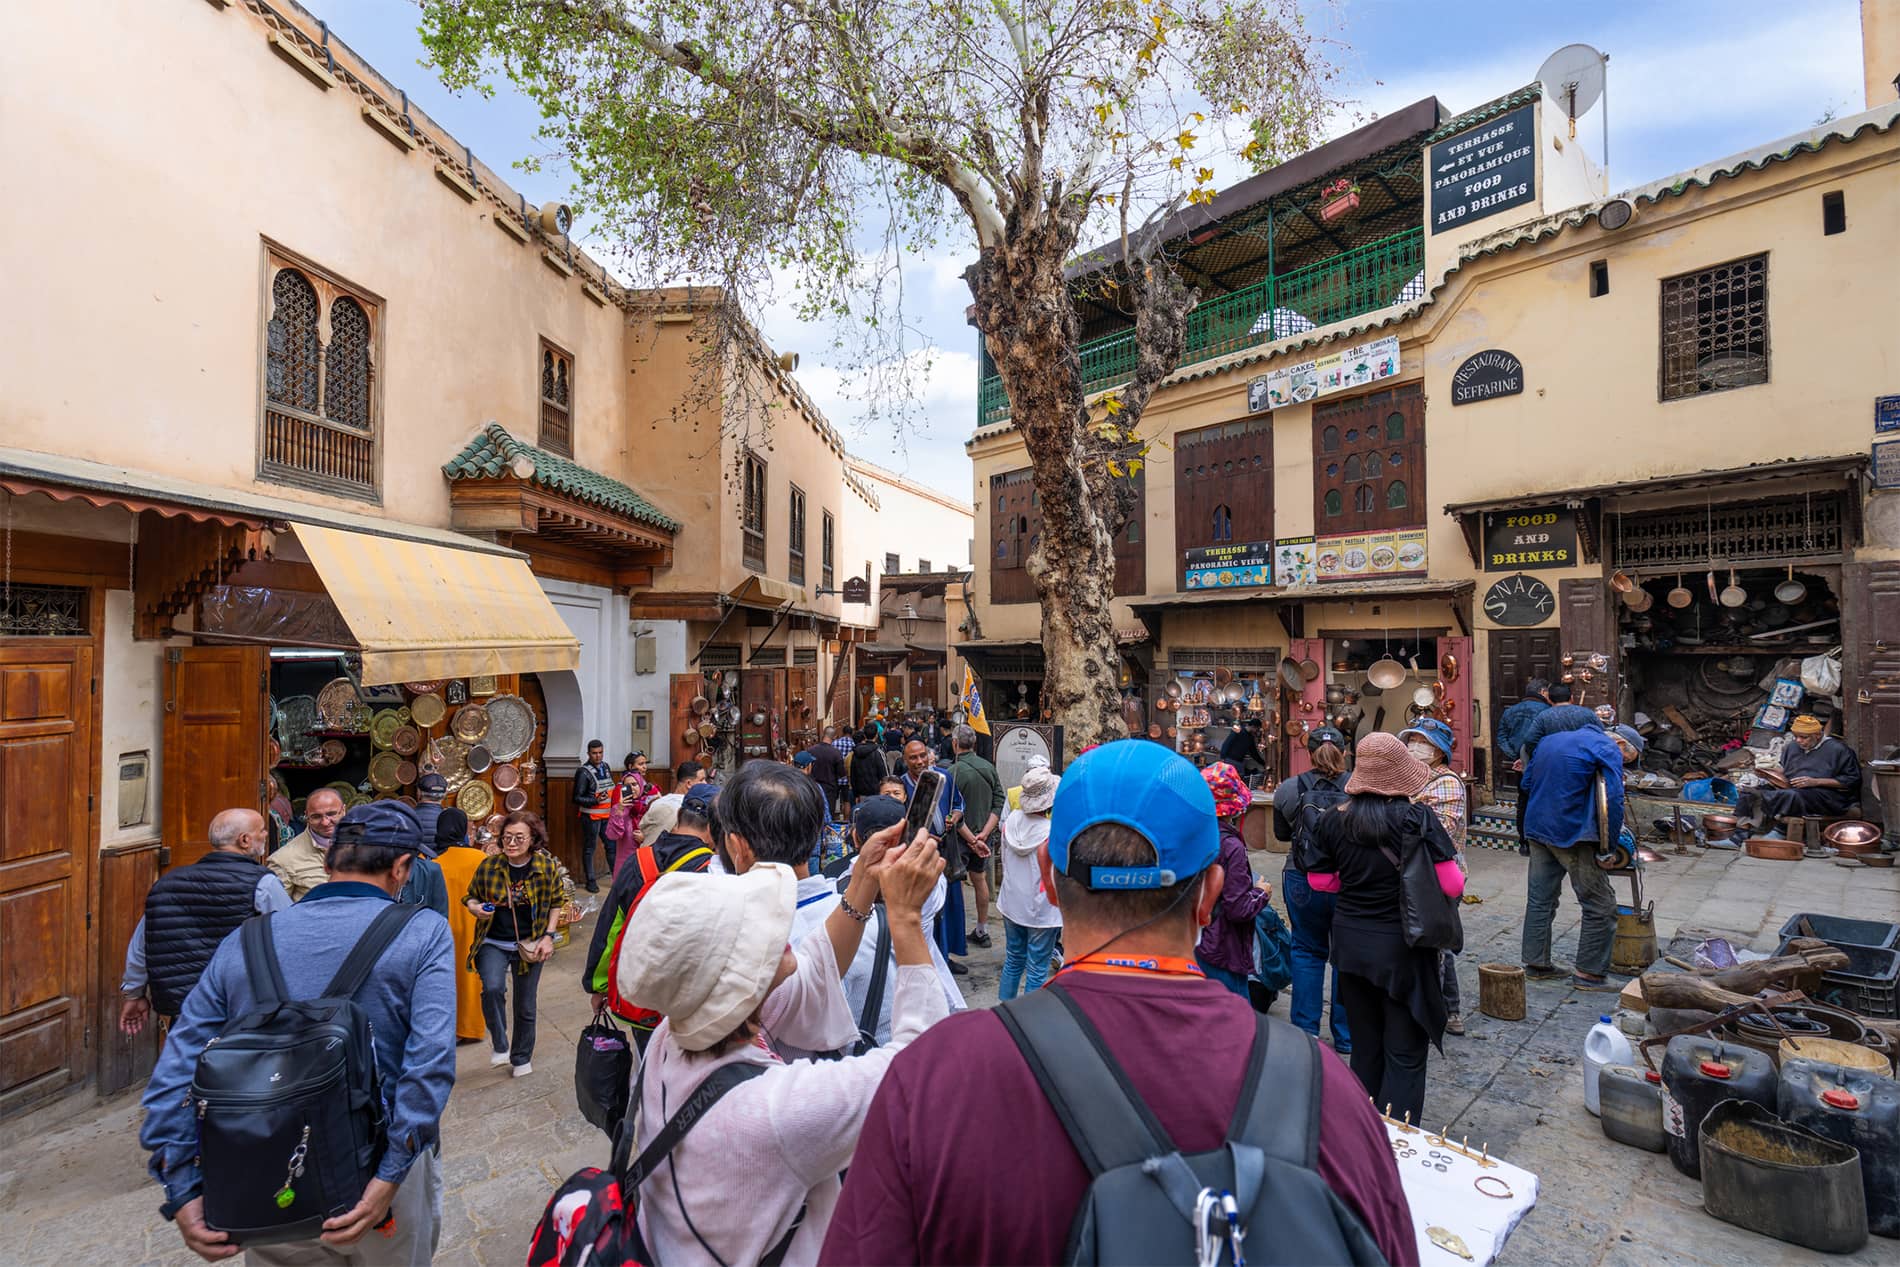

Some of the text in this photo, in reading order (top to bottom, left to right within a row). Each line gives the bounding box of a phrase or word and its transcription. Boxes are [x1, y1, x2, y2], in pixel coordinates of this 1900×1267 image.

[1448, 122, 1515, 155] TERRASSE
[1457, 141, 1504, 167] ET VUE
[1434, 146, 1531, 189] PANORAMIQUE
[1464, 174, 1502, 197] FOOD
[1438, 182, 1528, 224] AND DRINKS
[1290, 361, 1316, 374] CAKES
[1455, 353, 1521, 386] RESTAURANT
[1456, 377, 1518, 401] SEFFARINE
[1506, 513, 1558, 528] FOOD
[1205, 545, 1247, 556] TERRASSE
[1513, 533, 1550, 545] AND
[1190, 558, 1265, 570] PANORAMIC VIEW
[1491, 549, 1568, 565] DRINKS
[1484, 577, 1553, 619] SNACK
[1100, 872, 1154, 886] adisi
